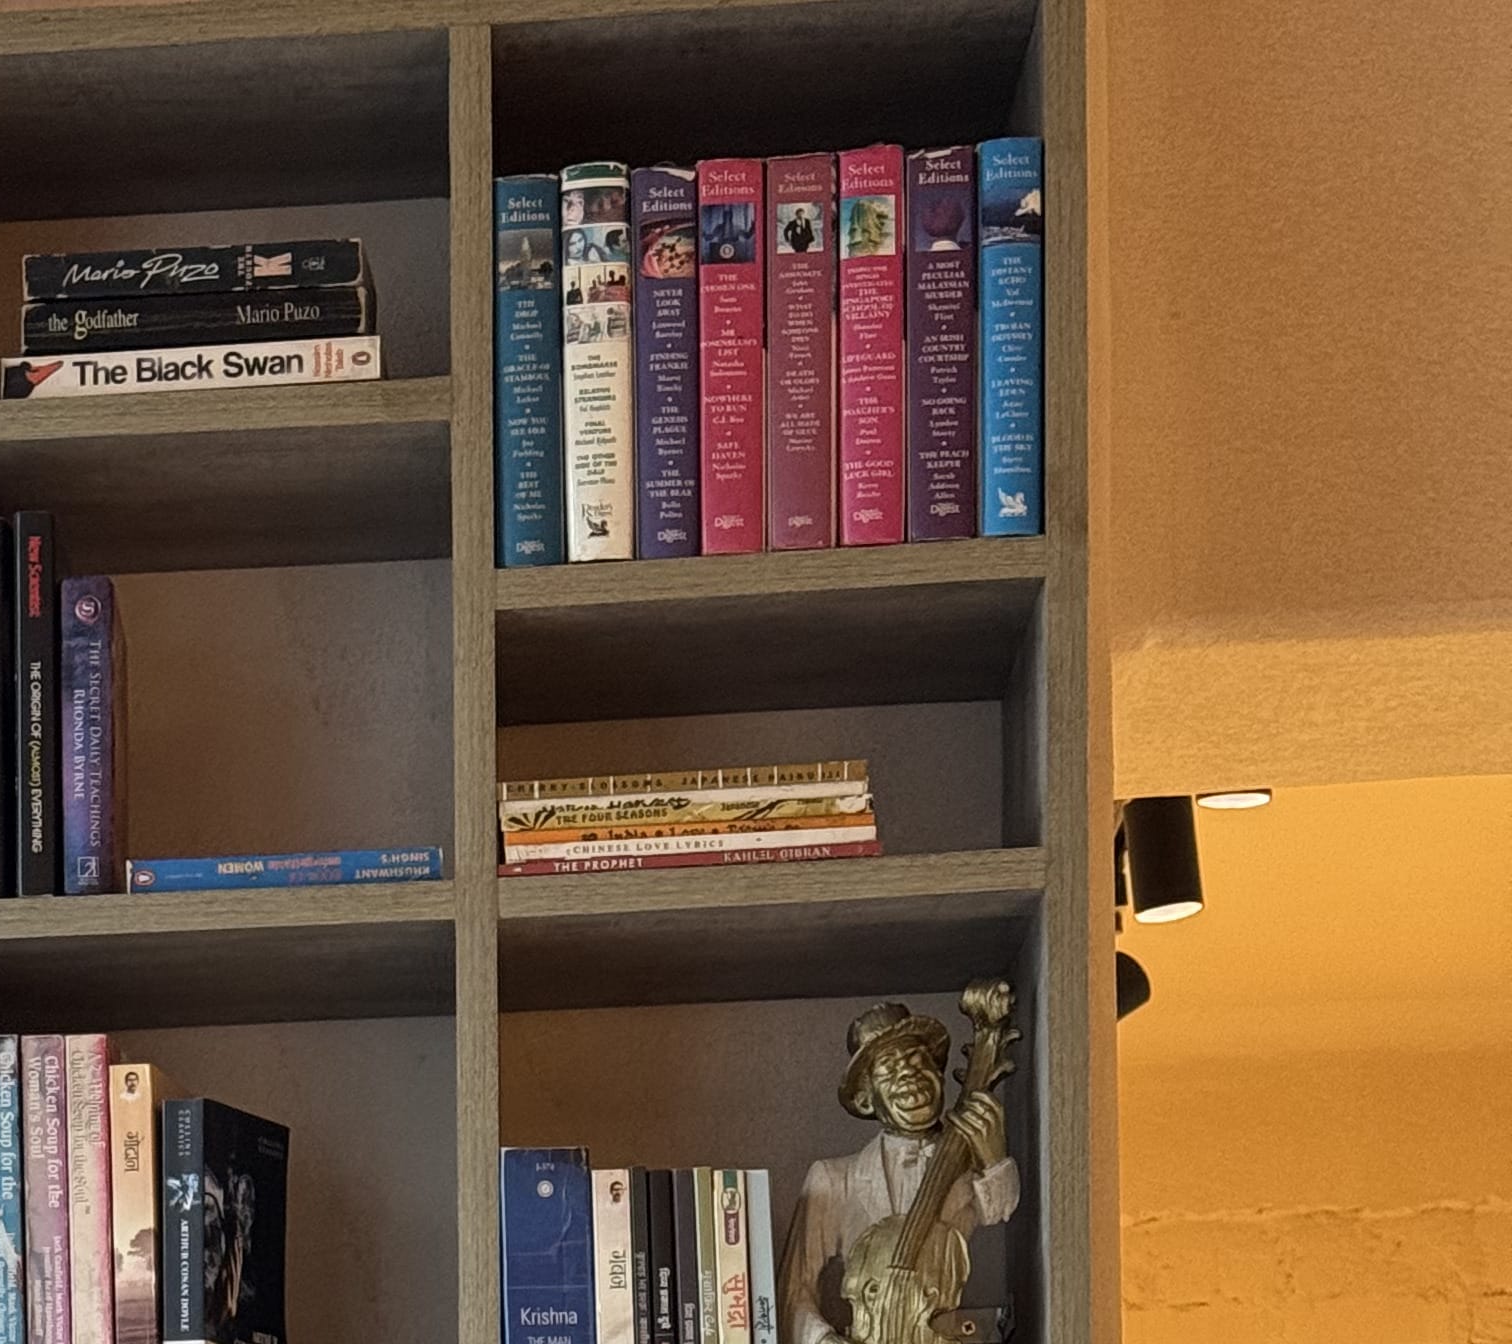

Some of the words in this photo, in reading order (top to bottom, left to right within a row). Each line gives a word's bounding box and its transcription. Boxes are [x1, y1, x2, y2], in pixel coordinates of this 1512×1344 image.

[649, 187, 684, 198] Select
[642, 201, 692, 213] Editions
[236, 305, 280, 325] Mario
[284, 302, 320, 321] Puzo
[48, 313, 67, 331] the
[73, 309, 139, 339] godfather
[73, 360, 127, 387] The
[136, 353, 214, 383] Black
[222, 351, 304, 377] Swan
[554, 862, 579, 872] THE
[585, 858, 643, 871] PROPHET
[722, 1272, 748, 1330] सुभद्रा
[520, 1308, 578, 1326] Krishna
